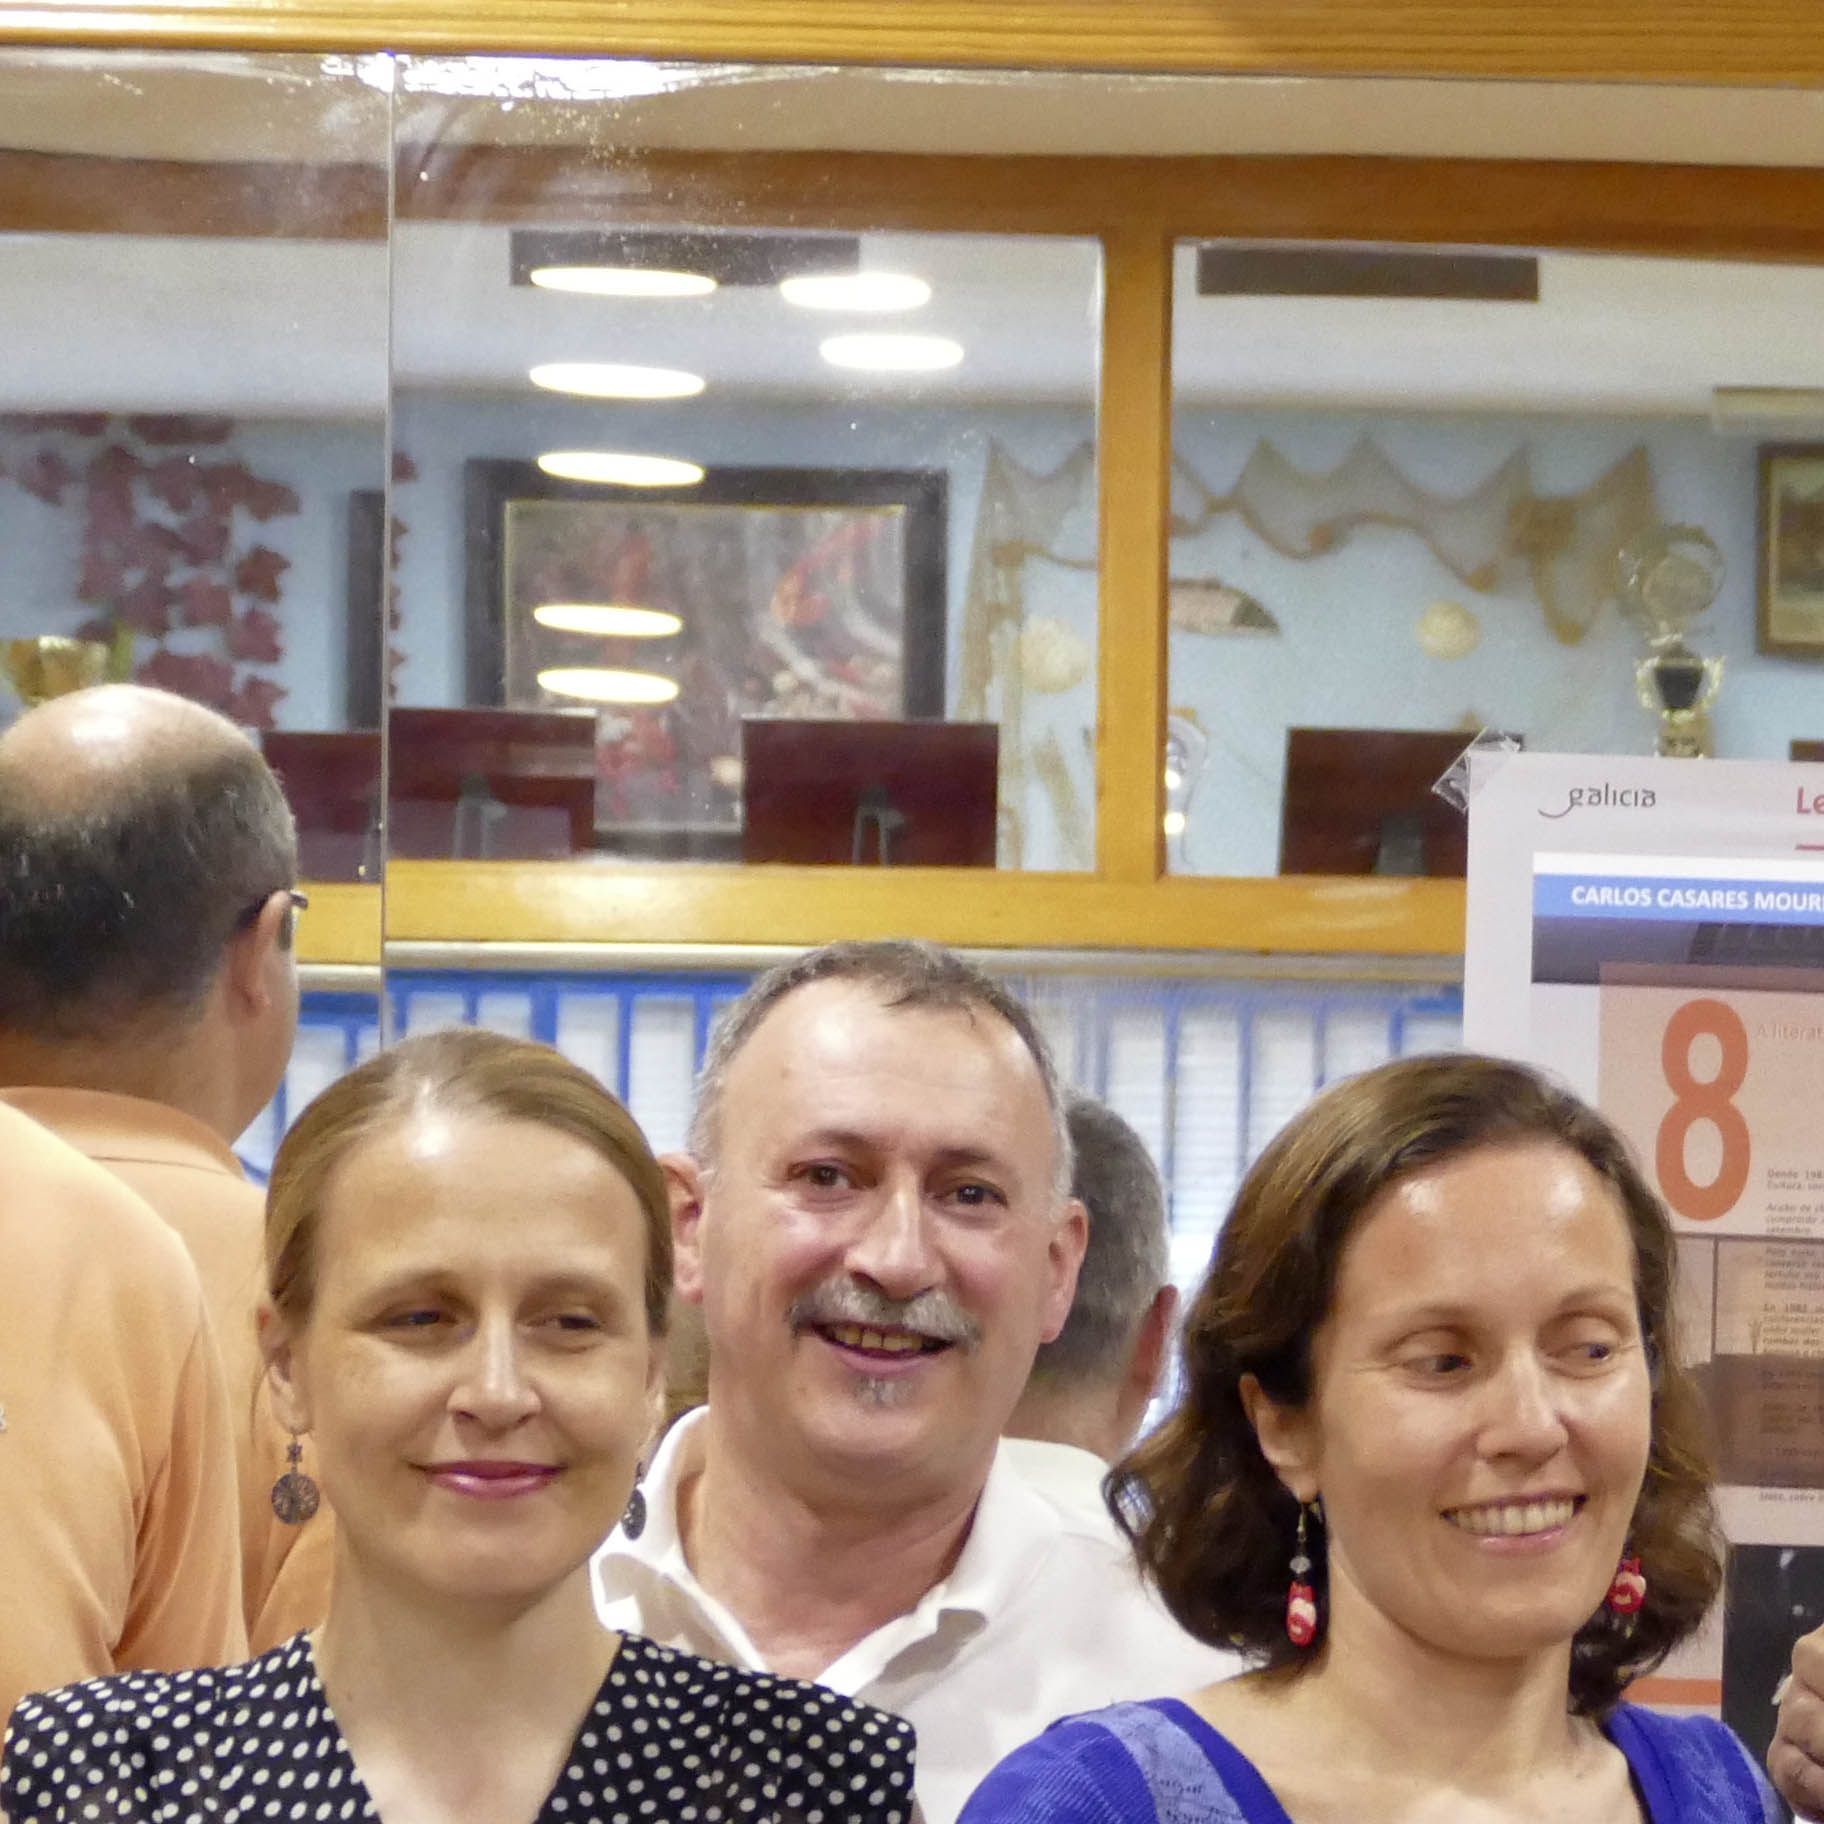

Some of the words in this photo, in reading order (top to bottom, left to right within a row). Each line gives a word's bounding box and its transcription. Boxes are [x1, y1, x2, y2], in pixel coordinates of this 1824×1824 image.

[1538, 783, 1656, 819] galicia
[1571, 886, 1651, 907] CARLOS
[1657, 888, 1749, 909] CASARES
[1655, 997, 1751, 1222] 8
